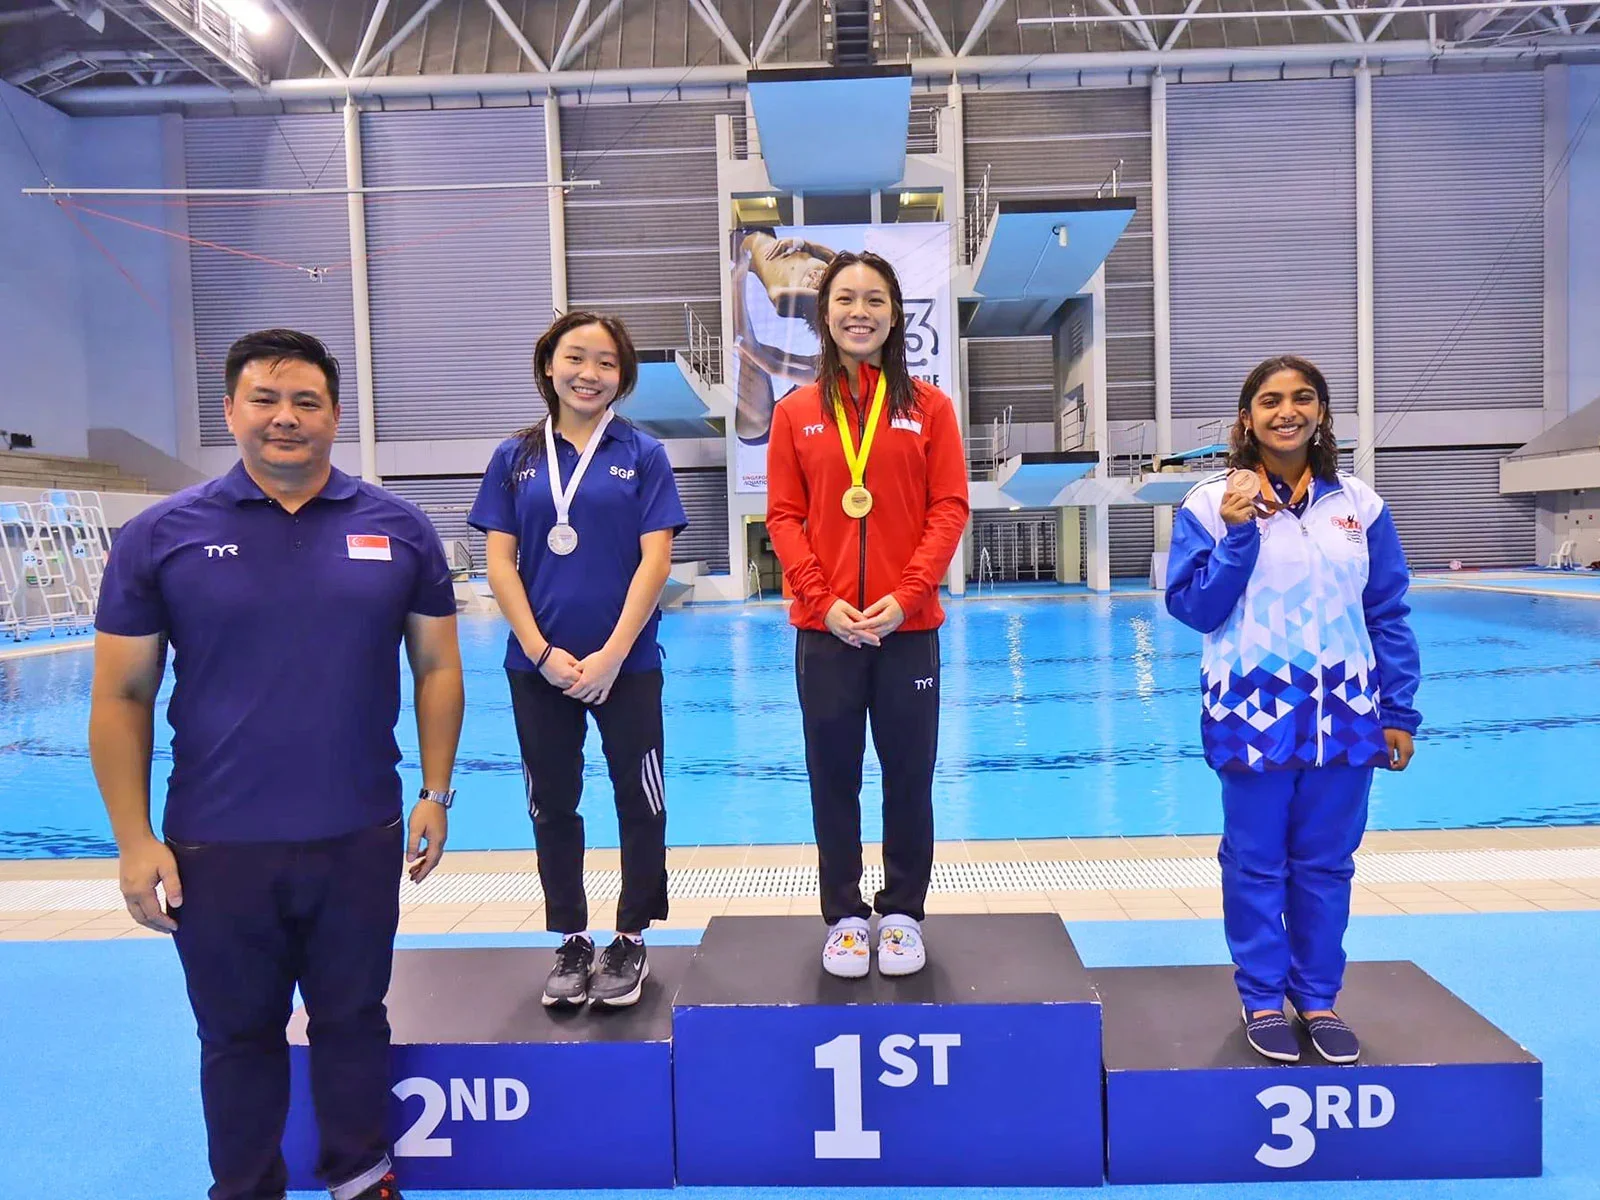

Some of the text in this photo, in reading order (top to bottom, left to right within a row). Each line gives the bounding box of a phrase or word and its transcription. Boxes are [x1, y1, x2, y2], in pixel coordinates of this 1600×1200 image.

[803, 424, 824, 437] TYR
[609, 465, 635, 480] SGP
[204, 544, 238, 557] TYR
[914, 677, 933, 690] TYR
[814, 1033, 961, 1159] 1ST
[391, 1076, 531, 1157] 2ND
[1254, 1084, 1395, 1168] 3RD
